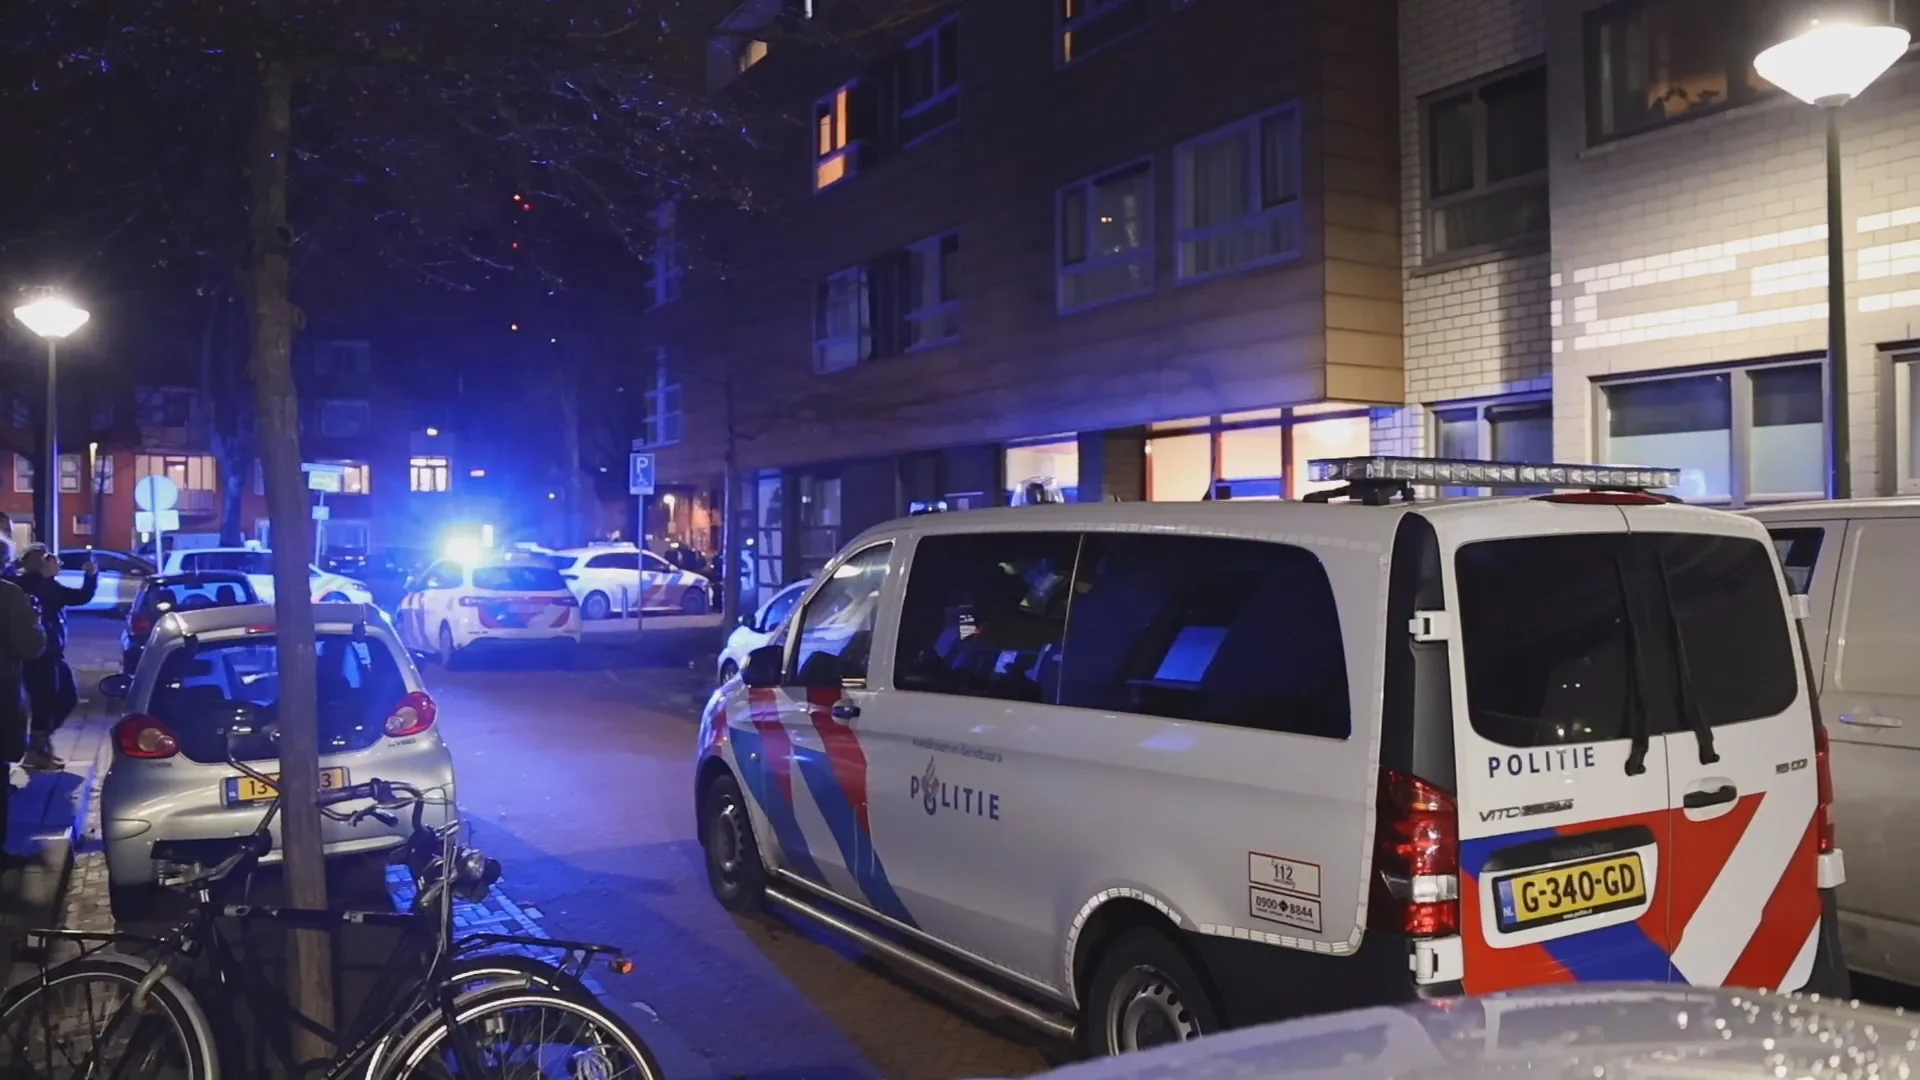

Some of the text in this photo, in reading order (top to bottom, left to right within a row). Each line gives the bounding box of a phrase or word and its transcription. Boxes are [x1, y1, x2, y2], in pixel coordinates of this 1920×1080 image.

[636, 456, 649, 474] P
[1487, 746, 1596, 779] POLITIE
[910, 775, 1000, 820] POLITIE
[1273, 864, 1294, 882] 112
[1521, 863, 1636, 914] G-340-GD
[1256, 896, 1277, 910] 0900
[1290, 904, 1312, 918] 8844
[1502, 907, 1515, 918] NL
